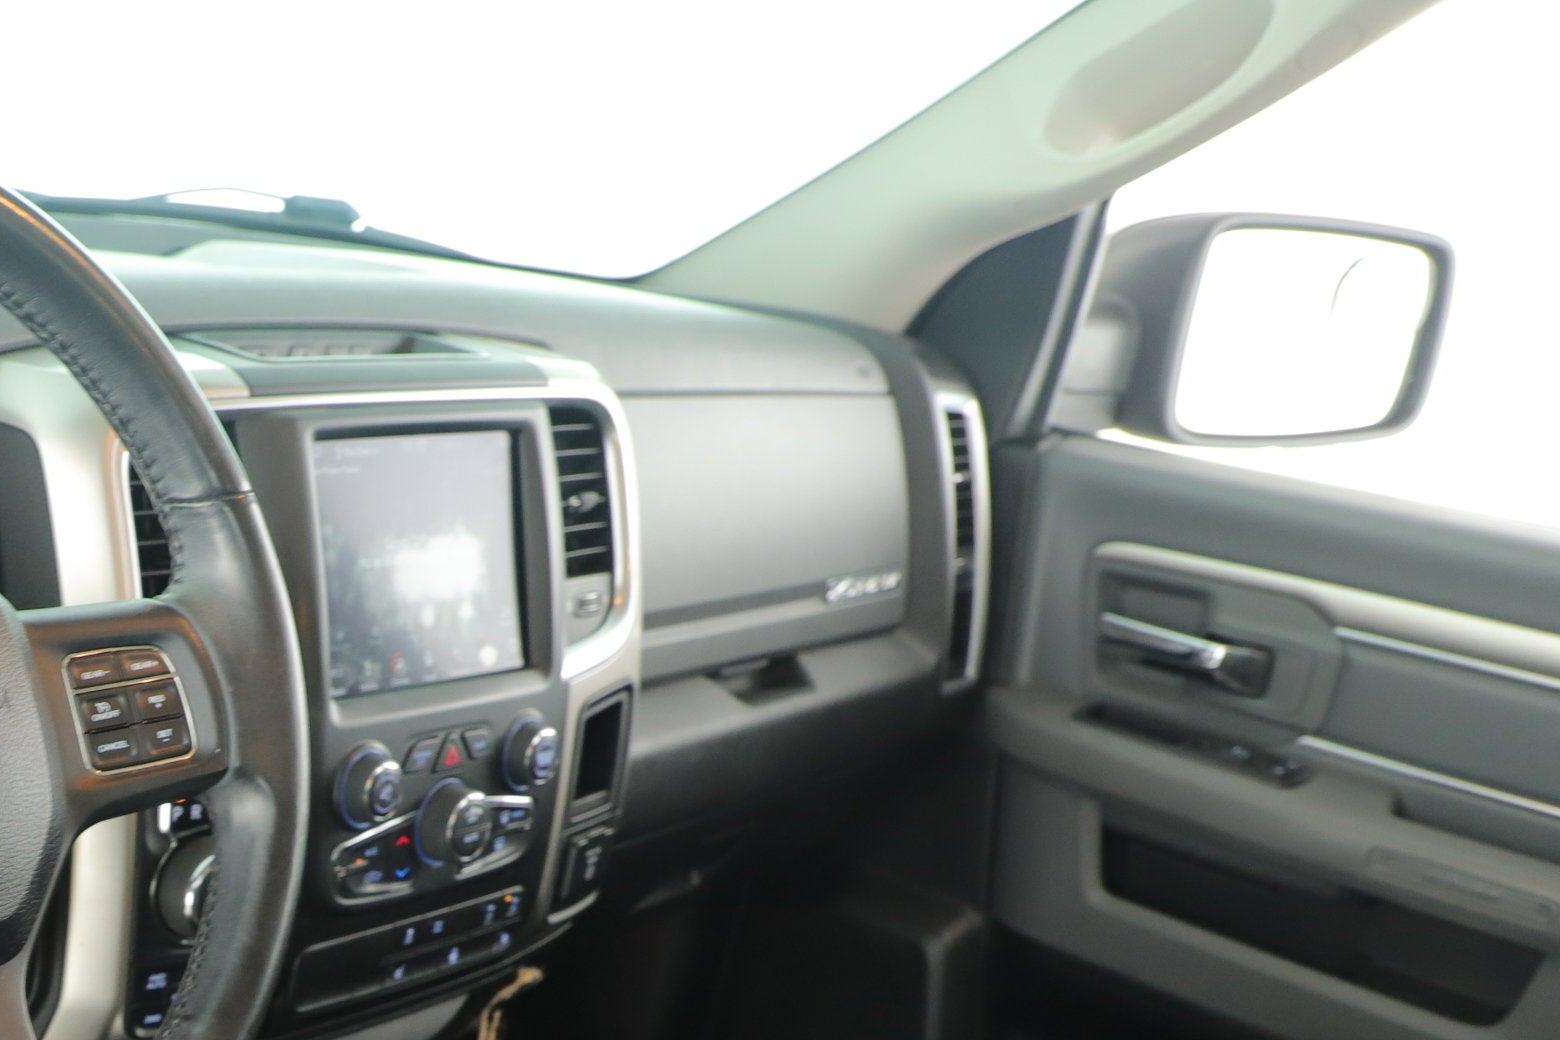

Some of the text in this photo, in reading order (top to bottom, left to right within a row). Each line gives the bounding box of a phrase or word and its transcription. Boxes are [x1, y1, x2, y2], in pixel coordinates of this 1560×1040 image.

[97, 740, 131, 753] CANCEL
[172, 804, 202, 822] P R
